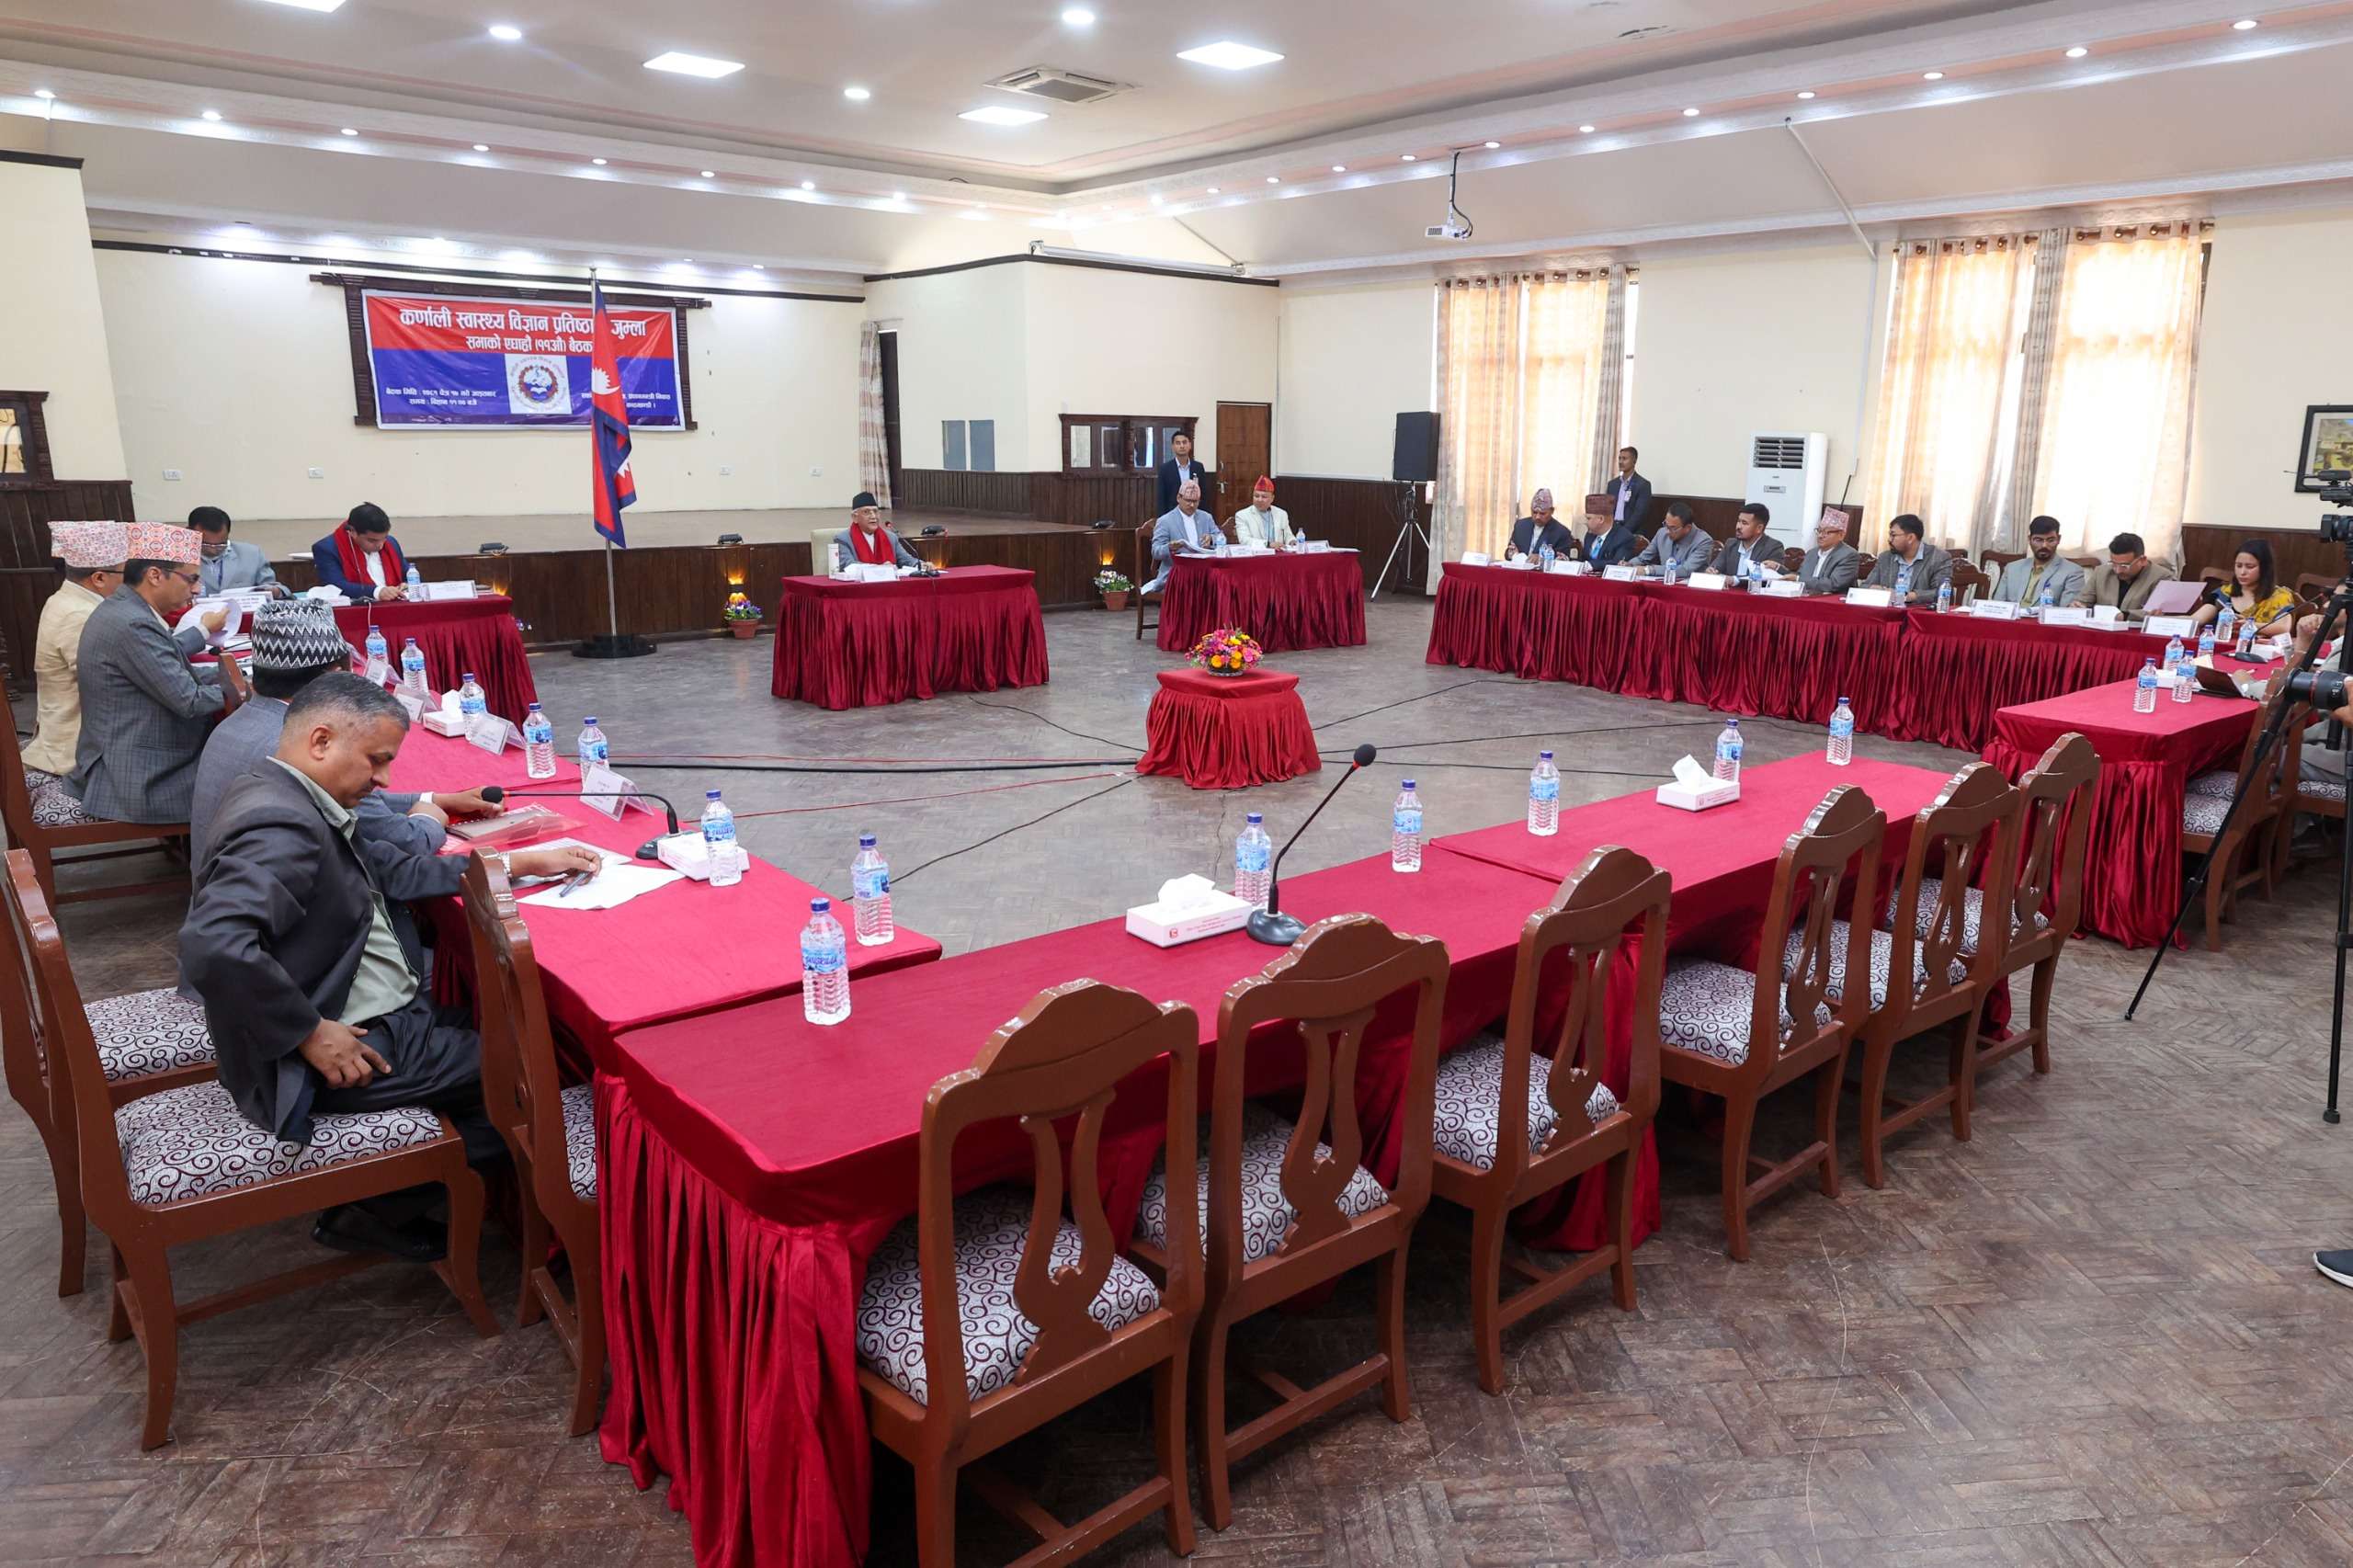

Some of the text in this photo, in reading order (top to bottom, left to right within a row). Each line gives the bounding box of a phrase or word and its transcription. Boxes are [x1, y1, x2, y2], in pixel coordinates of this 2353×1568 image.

[400, 305, 647, 340] कर्णाली स्वास्थ्य विज्ञान प्रतिष्ठा जुम्ला
